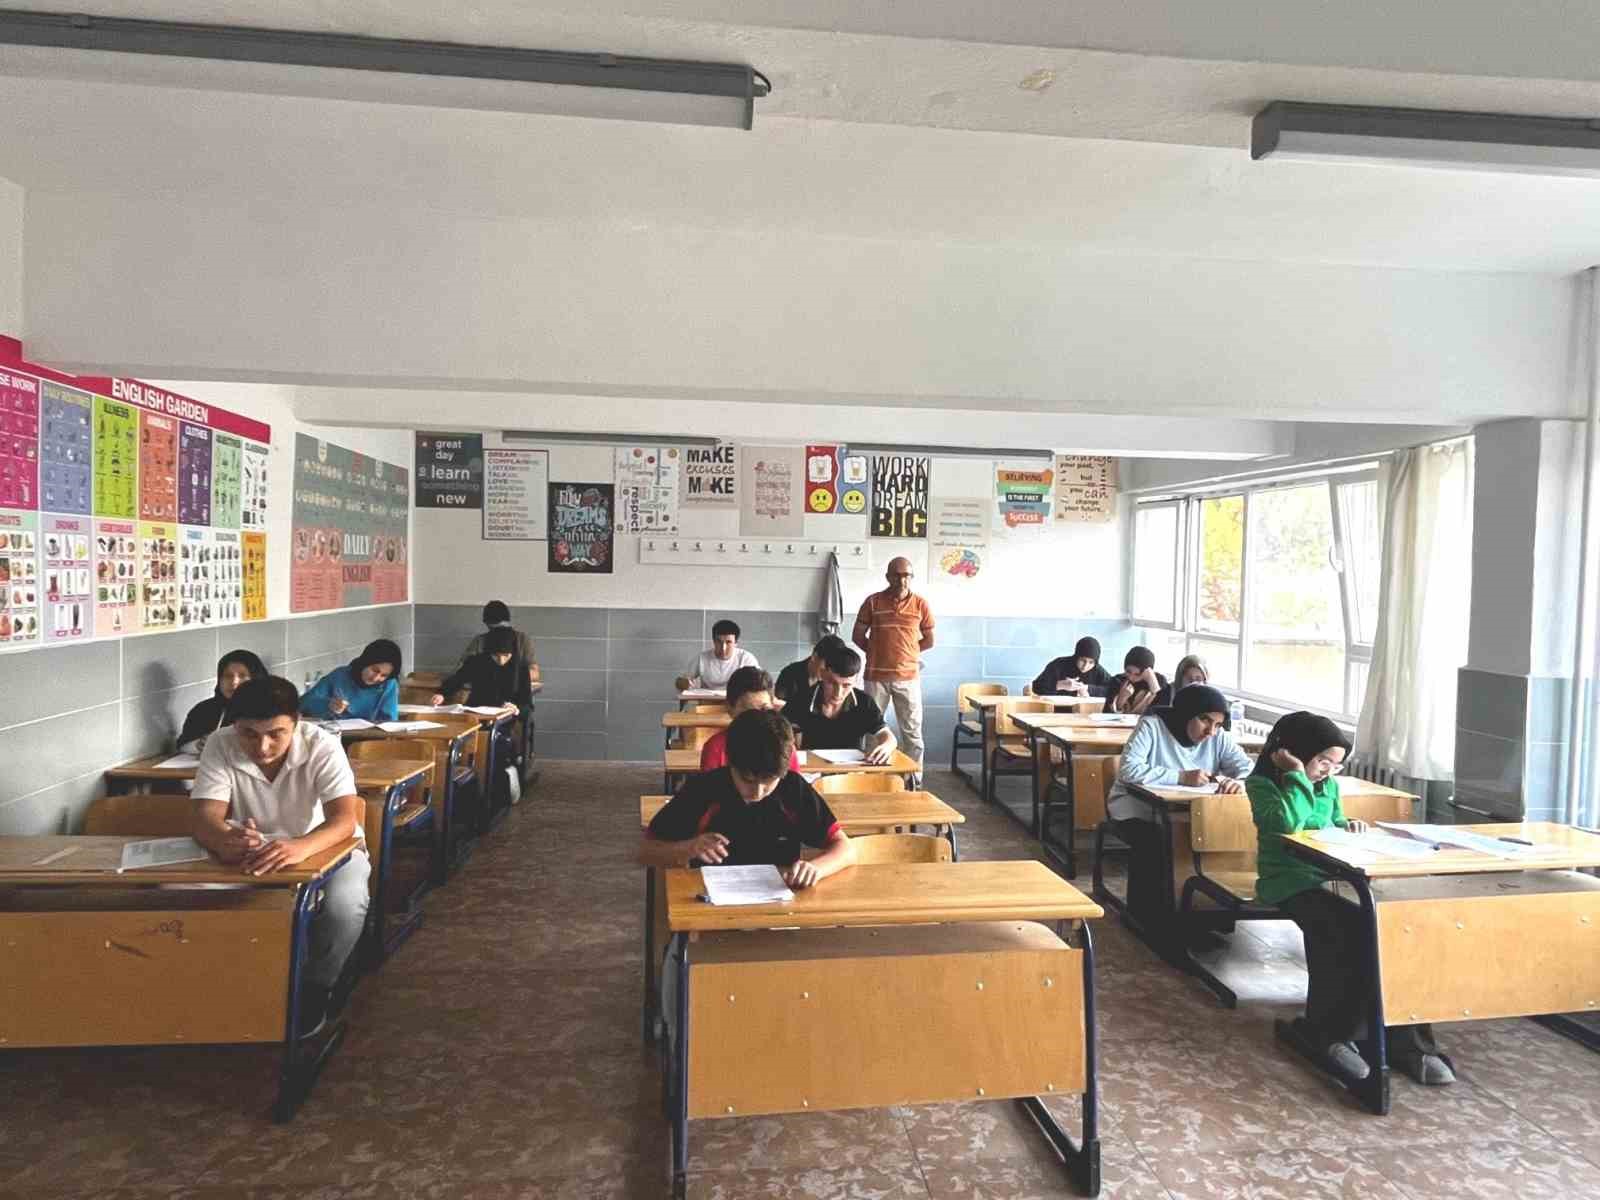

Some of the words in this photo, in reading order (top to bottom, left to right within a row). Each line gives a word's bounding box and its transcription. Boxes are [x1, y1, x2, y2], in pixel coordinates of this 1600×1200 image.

[112, 378, 164, 411] ENGLISH
[165, 393, 209, 424] GARDEN
[434, 440, 462, 450] great
[435, 449, 455, 462] day
[687, 446, 734, 463] MAKE
[431, 465, 470, 480] learn
[686, 464, 736, 475] excuses
[872, 456, 928, 478] WORK
[688, 476, 735, 494] MKE
[872, 473, 928, 494] HARD
[1080, 473, 1093, 481] but
[436, 494, 466, 505] new
[872, 490, 928, 511] DREAM
[630, 486, 640, 531] respect
[871, 506, 928, 538] BIG
